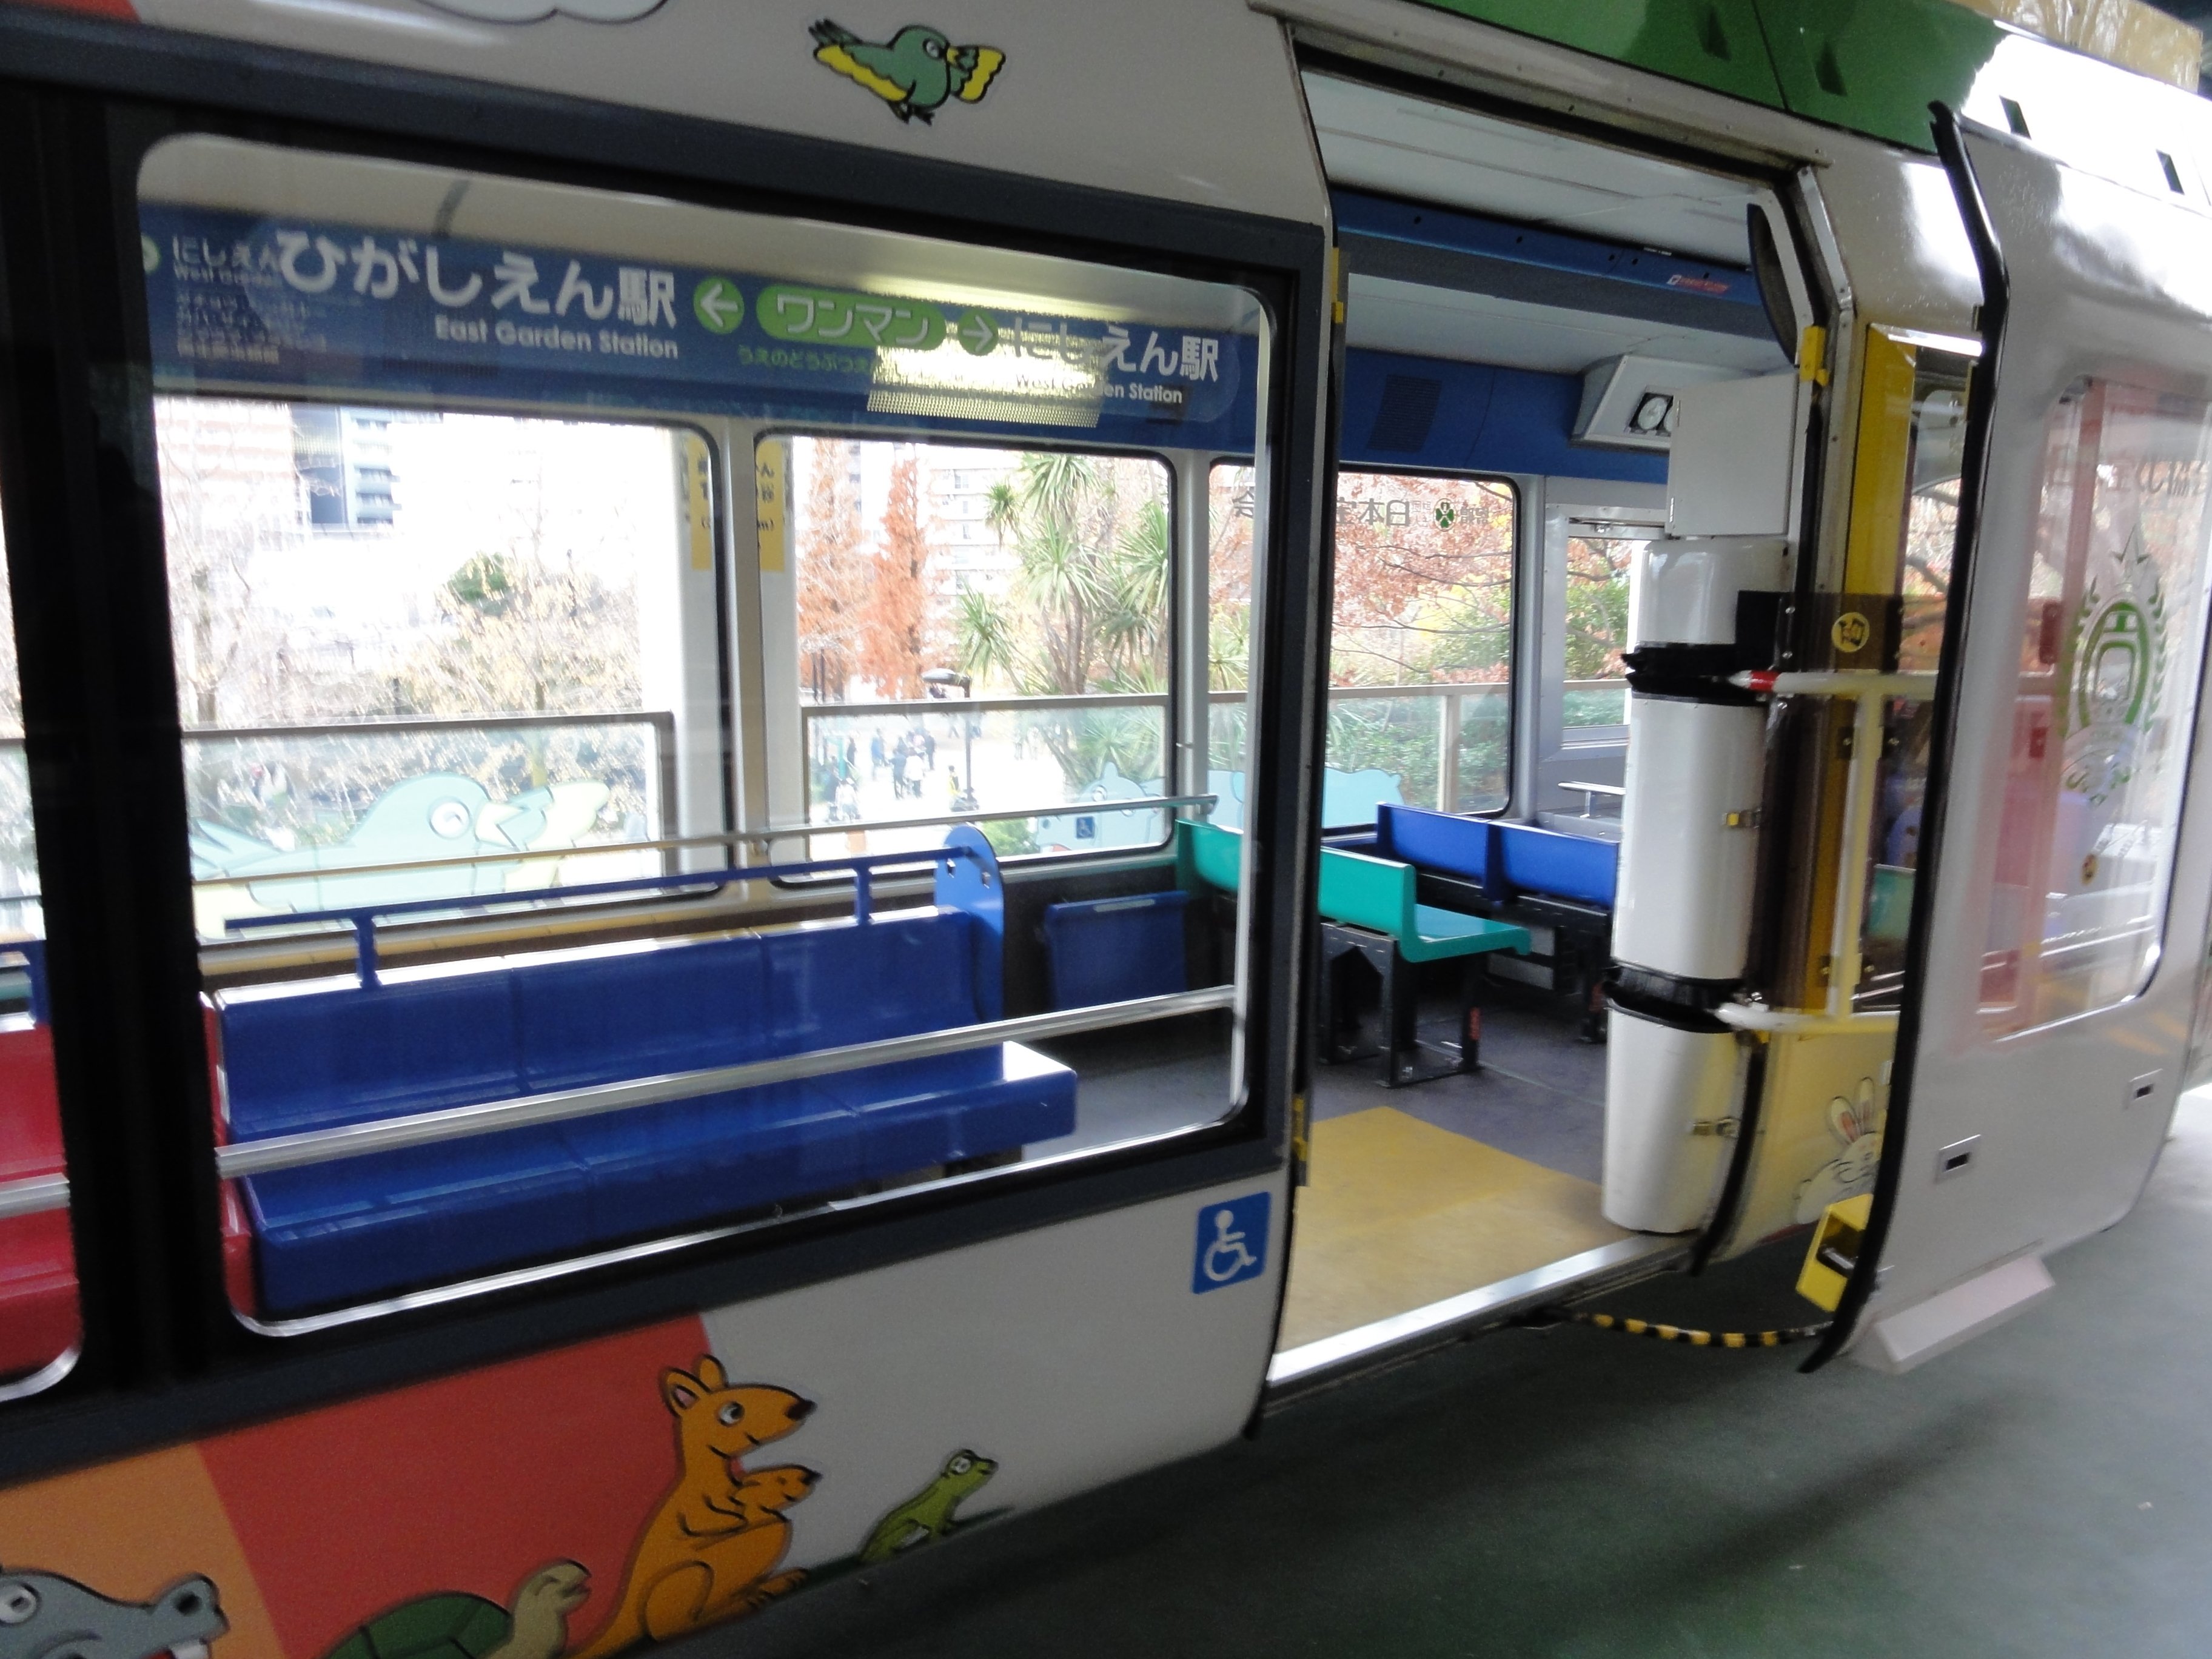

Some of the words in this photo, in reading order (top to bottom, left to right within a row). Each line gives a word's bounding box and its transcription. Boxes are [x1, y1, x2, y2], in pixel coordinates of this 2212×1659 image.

[276, 230, 677, 329] ひがしえん駅
[434, 314, 488, 343] East
[495, 320, 592, 353] Garden
[599, 329, 679, 360] Station
[777, 295, 928, 346] ワンマン
[1014, 317, 1219, 383] にしえん駅
[1129, 382, 1182, 404] Station
